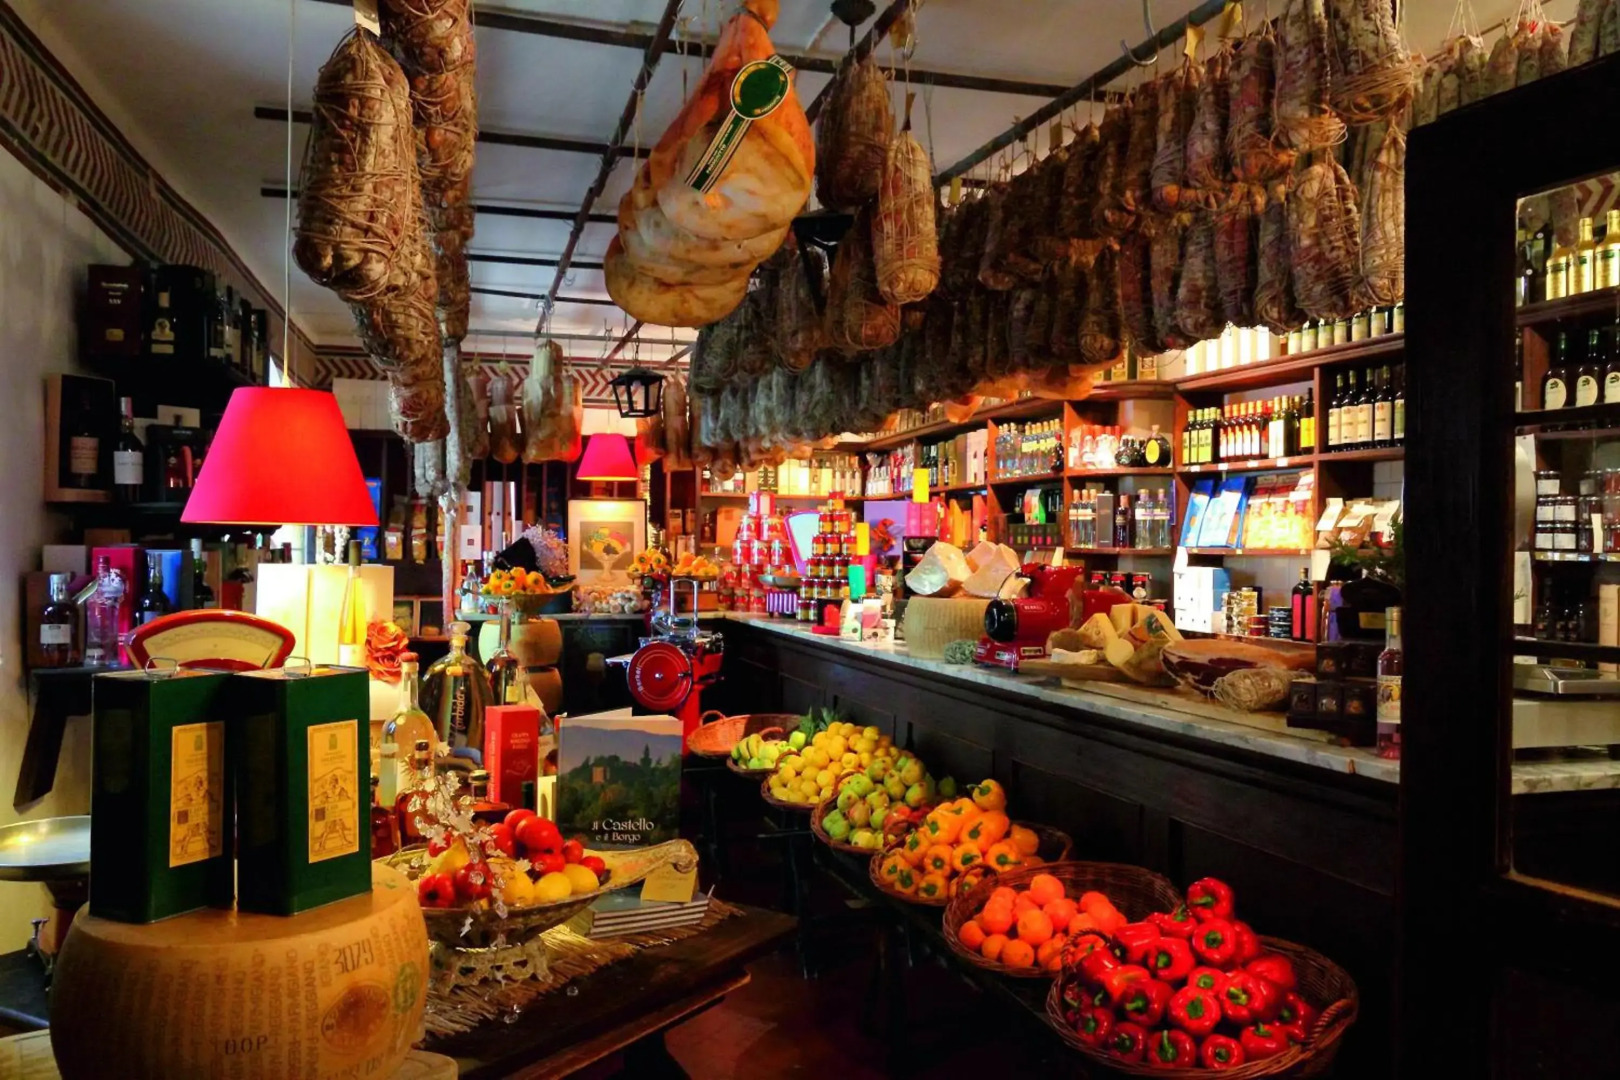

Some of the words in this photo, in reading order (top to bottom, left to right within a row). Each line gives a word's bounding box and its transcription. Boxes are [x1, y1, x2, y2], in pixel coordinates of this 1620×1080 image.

[602, 817, 655, 831] Castello
[603, 832, 609, 841] il
[612, 832, 641, 844] Borgo
[334, 938, 375, 977] 3079
[225, 1035, 268, 1056] DOP
